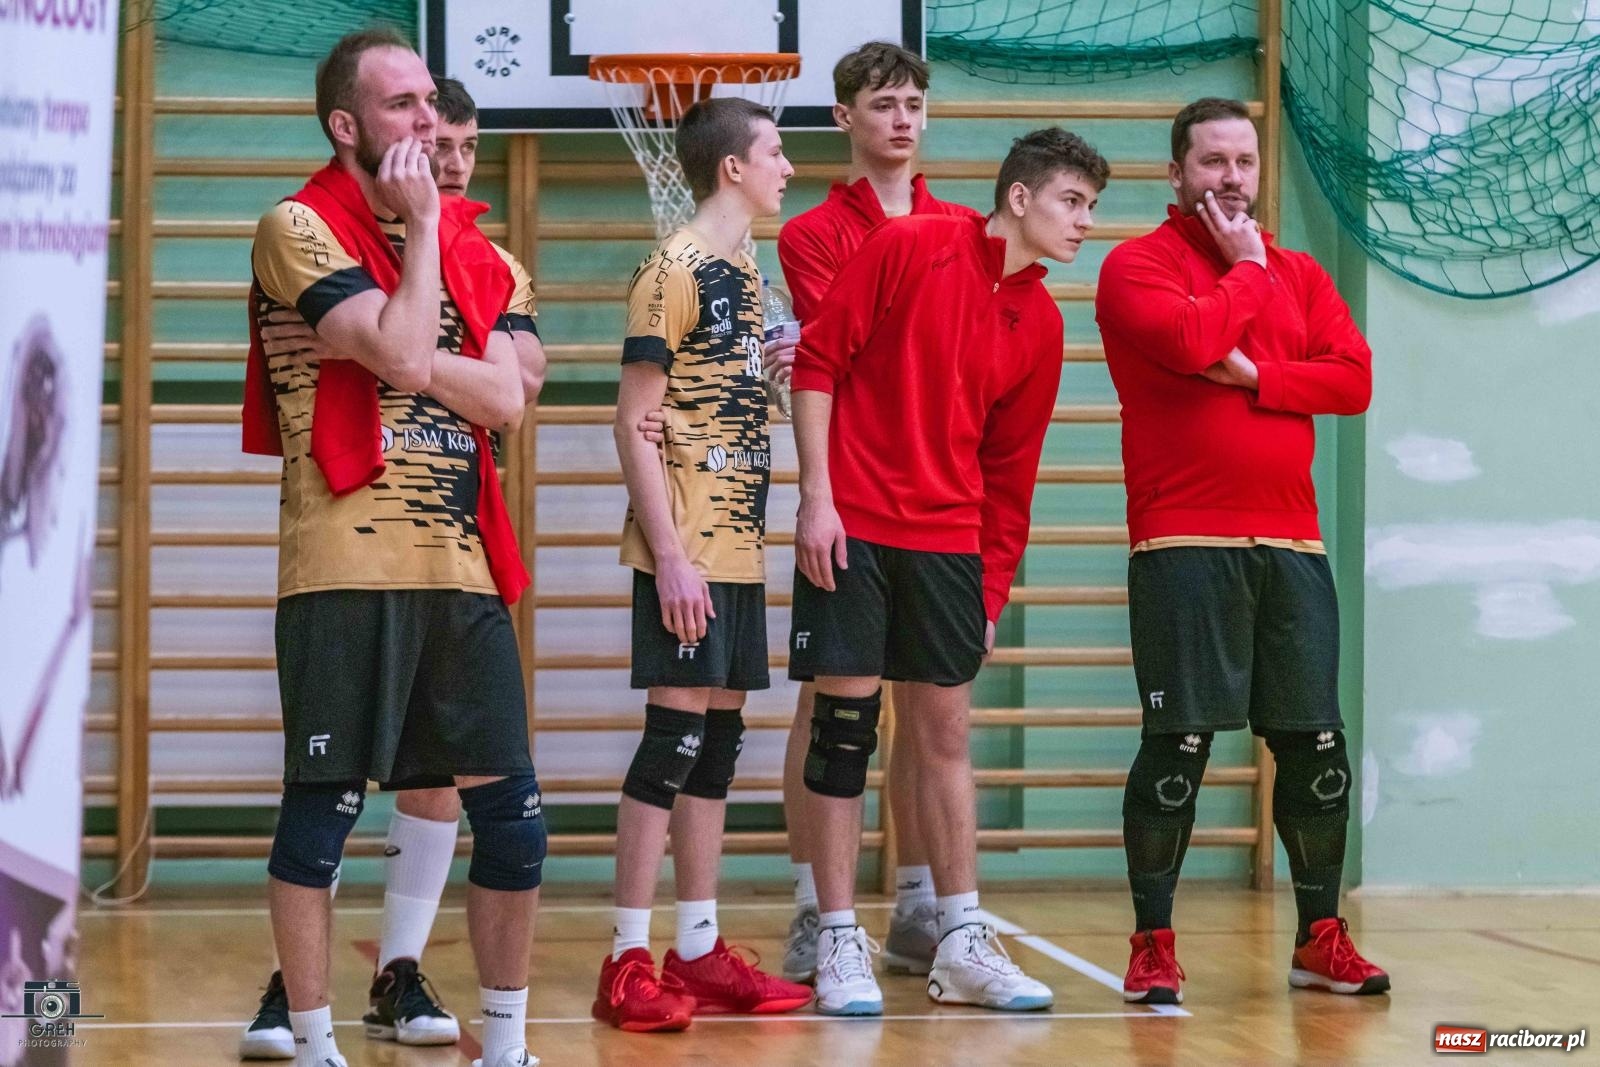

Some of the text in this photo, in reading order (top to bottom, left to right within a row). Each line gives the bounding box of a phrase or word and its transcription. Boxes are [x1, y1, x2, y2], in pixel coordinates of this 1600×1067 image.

[475, 26, 521, 45] SURE
[475, 59, 521, 77] SHOT
[741, 335, 762, 378] 18
[403, 427, 443, 450] JSW
